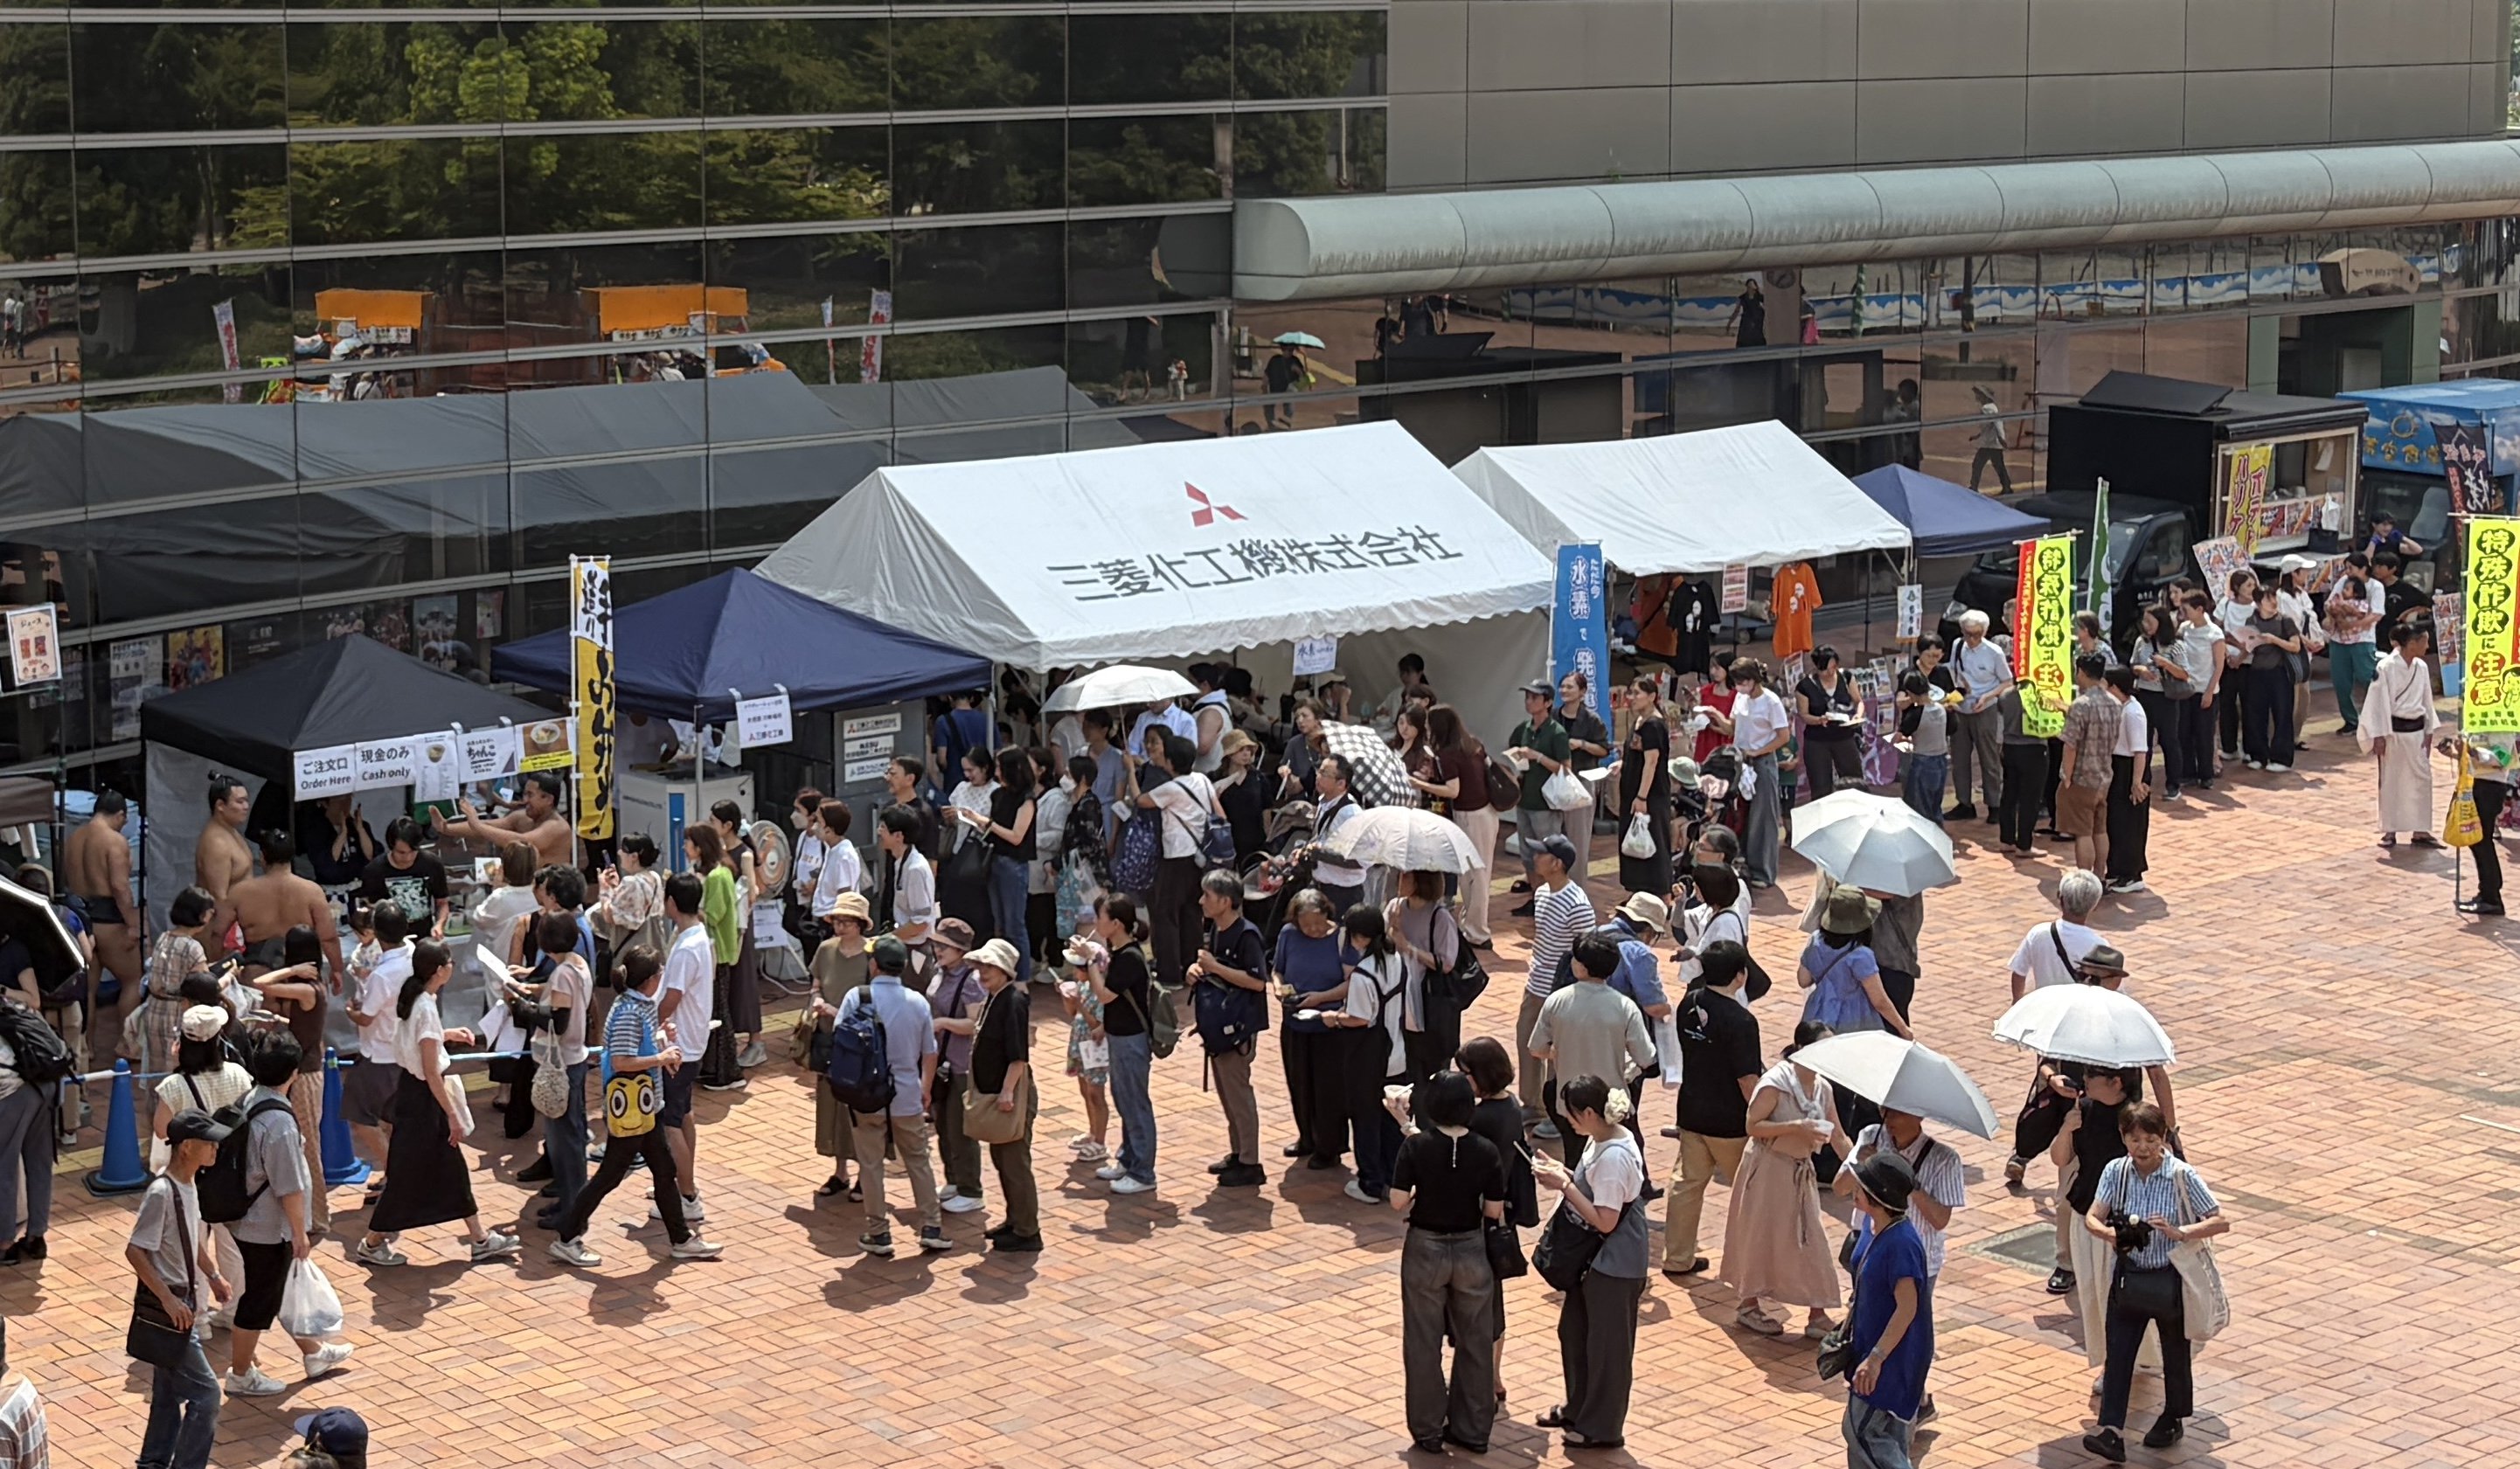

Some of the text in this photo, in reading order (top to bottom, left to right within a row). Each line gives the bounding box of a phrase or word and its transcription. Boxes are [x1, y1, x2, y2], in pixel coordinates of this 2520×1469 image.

[1046, 524, 1463, 601] 三菱化工機株式会社
[2472, 529, 2514, 705] 特殊詐欺に注意
[360, 745, 410, 764] 現金のみ
[467, 745, 496, 760] ちゃんこ
[302, 757, 348, 776] ご注文口
[361, 769, 386, 782] Cash
[388, 766, 411, 782] only
[301, 774, 351, 791] Order Here
